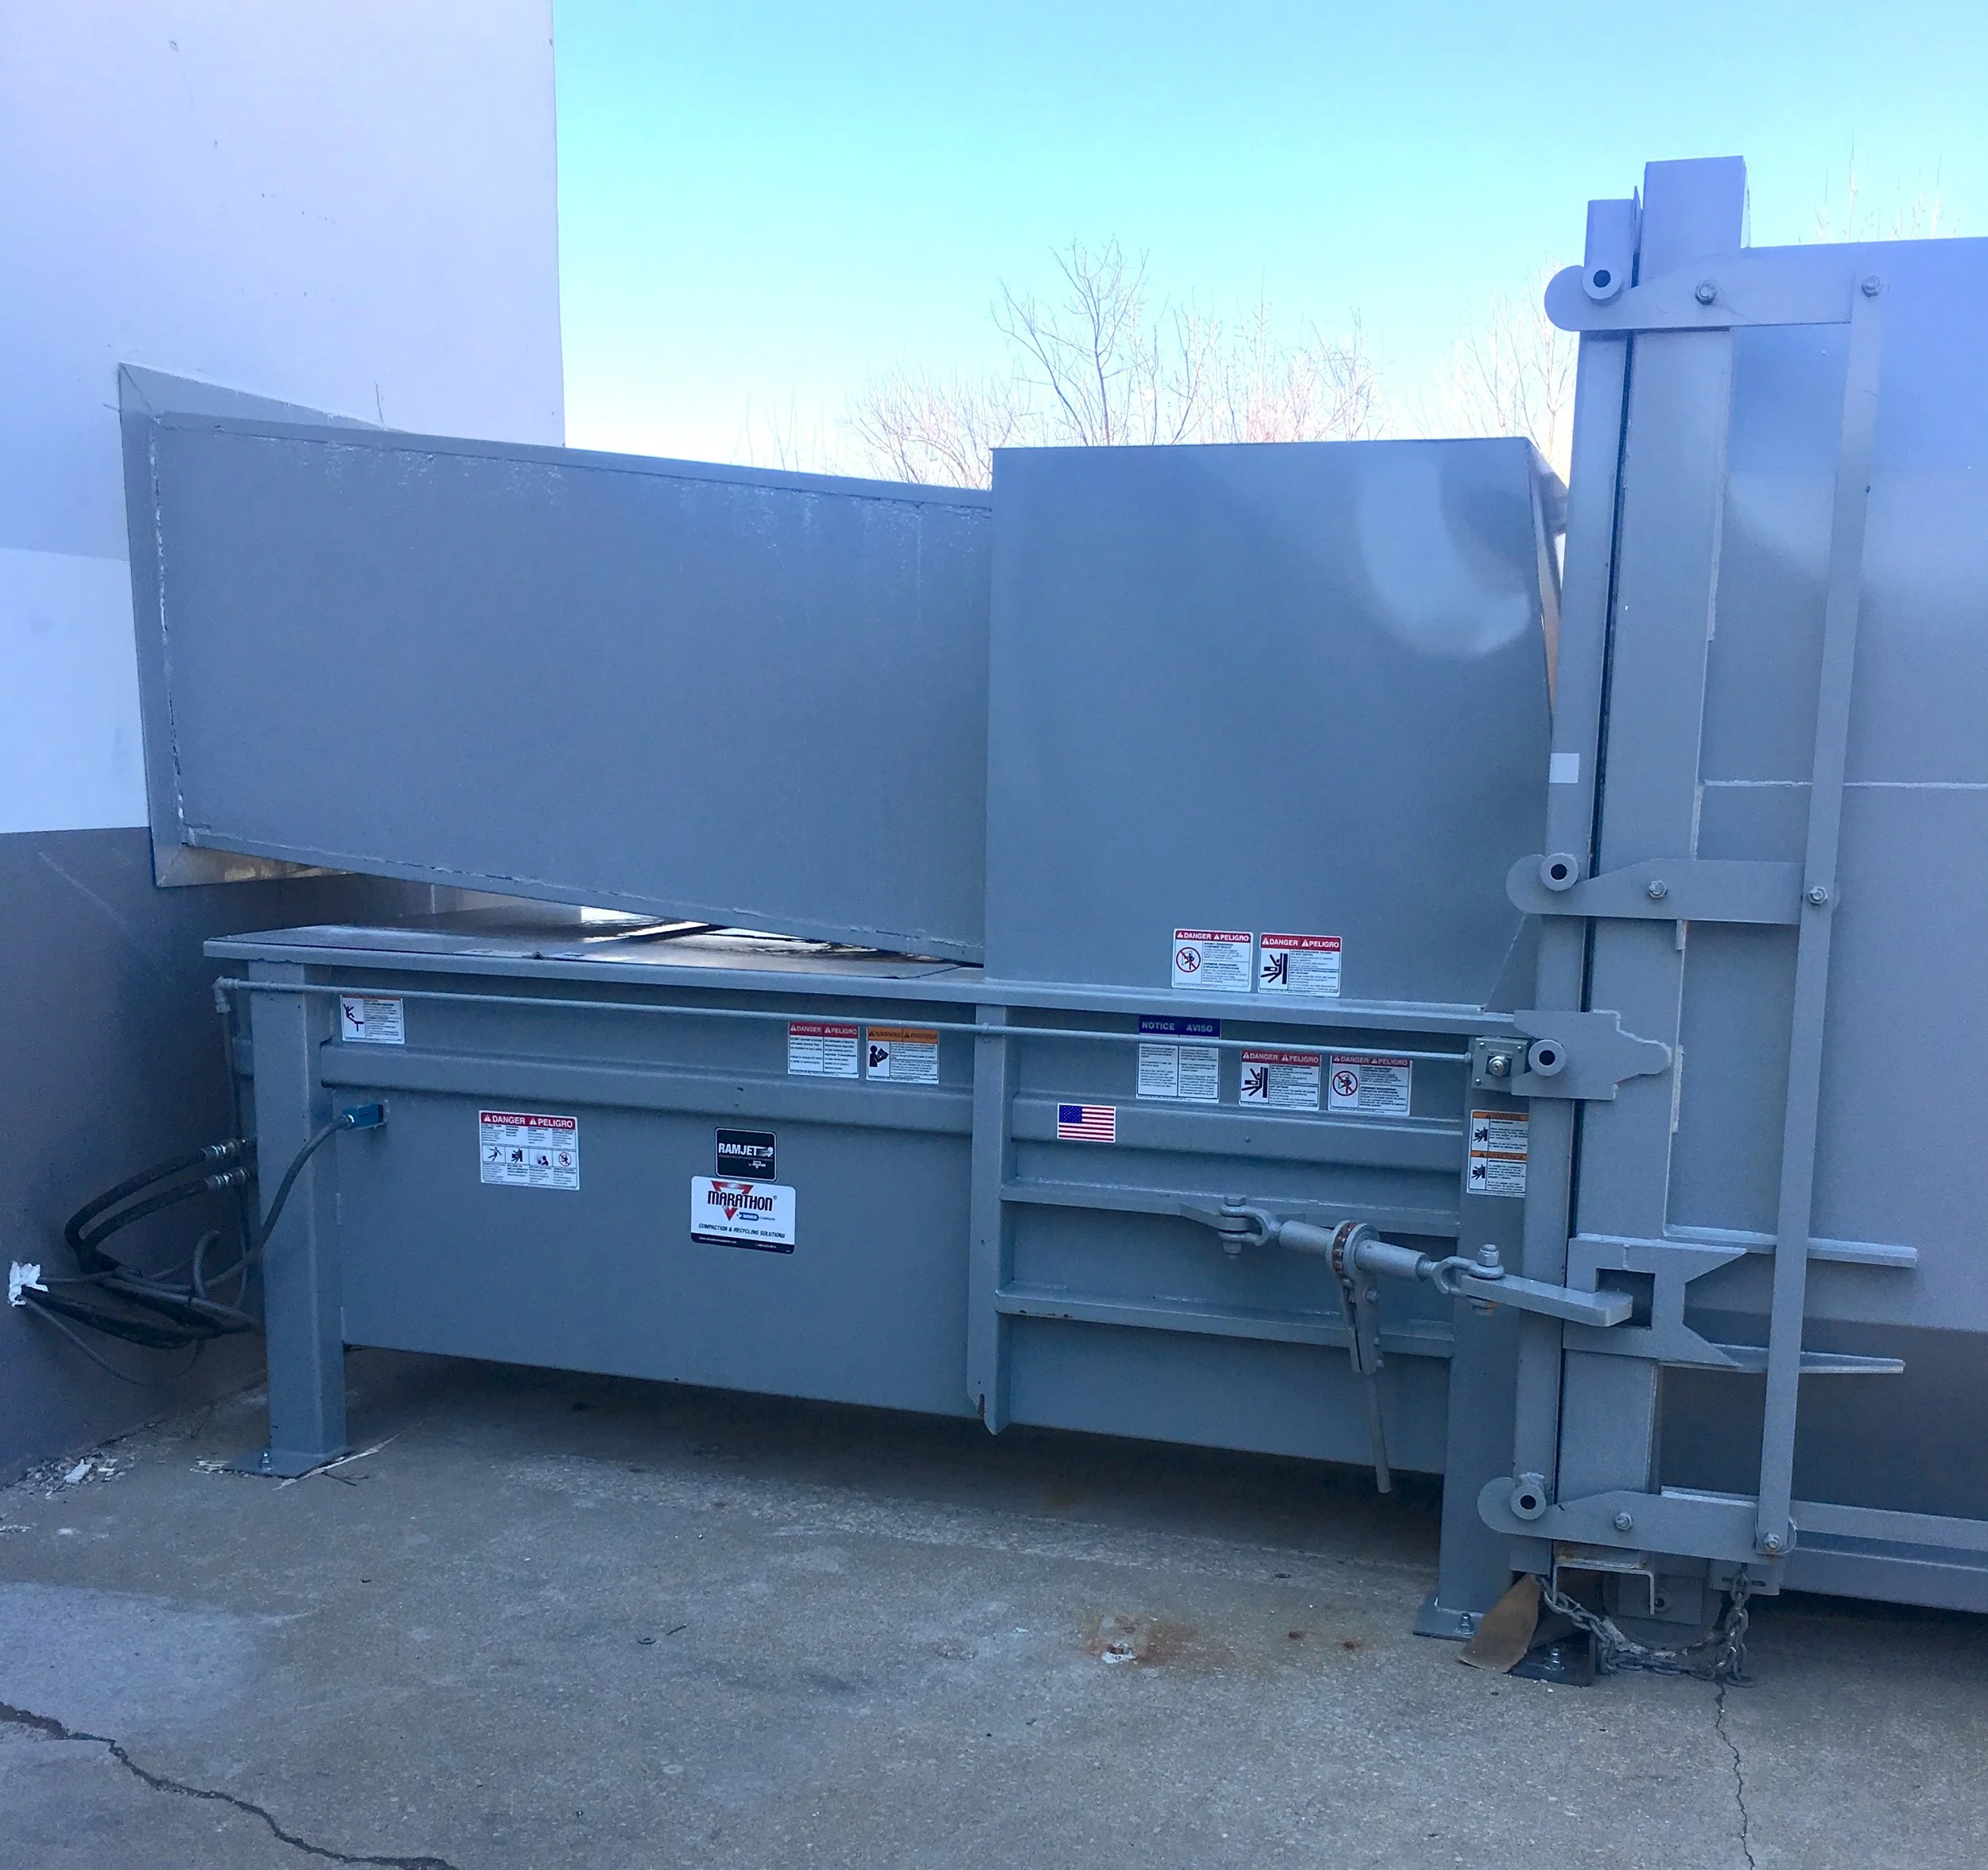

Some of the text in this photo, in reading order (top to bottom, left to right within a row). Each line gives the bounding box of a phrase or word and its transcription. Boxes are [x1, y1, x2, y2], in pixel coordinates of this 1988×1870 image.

[1142, 1021, 1213, 1033] NOTICE AVISO
[492, 1115, 573, 1128] DANGER PELIGRO
[718, 1143, 758, 1156] RAMJET
[707, 1190, 773, 1212] MARATHON
[698, 1223, 728, 1232] COMPACTION
[759, 1230, 786, 1239] SOLUTIONS
